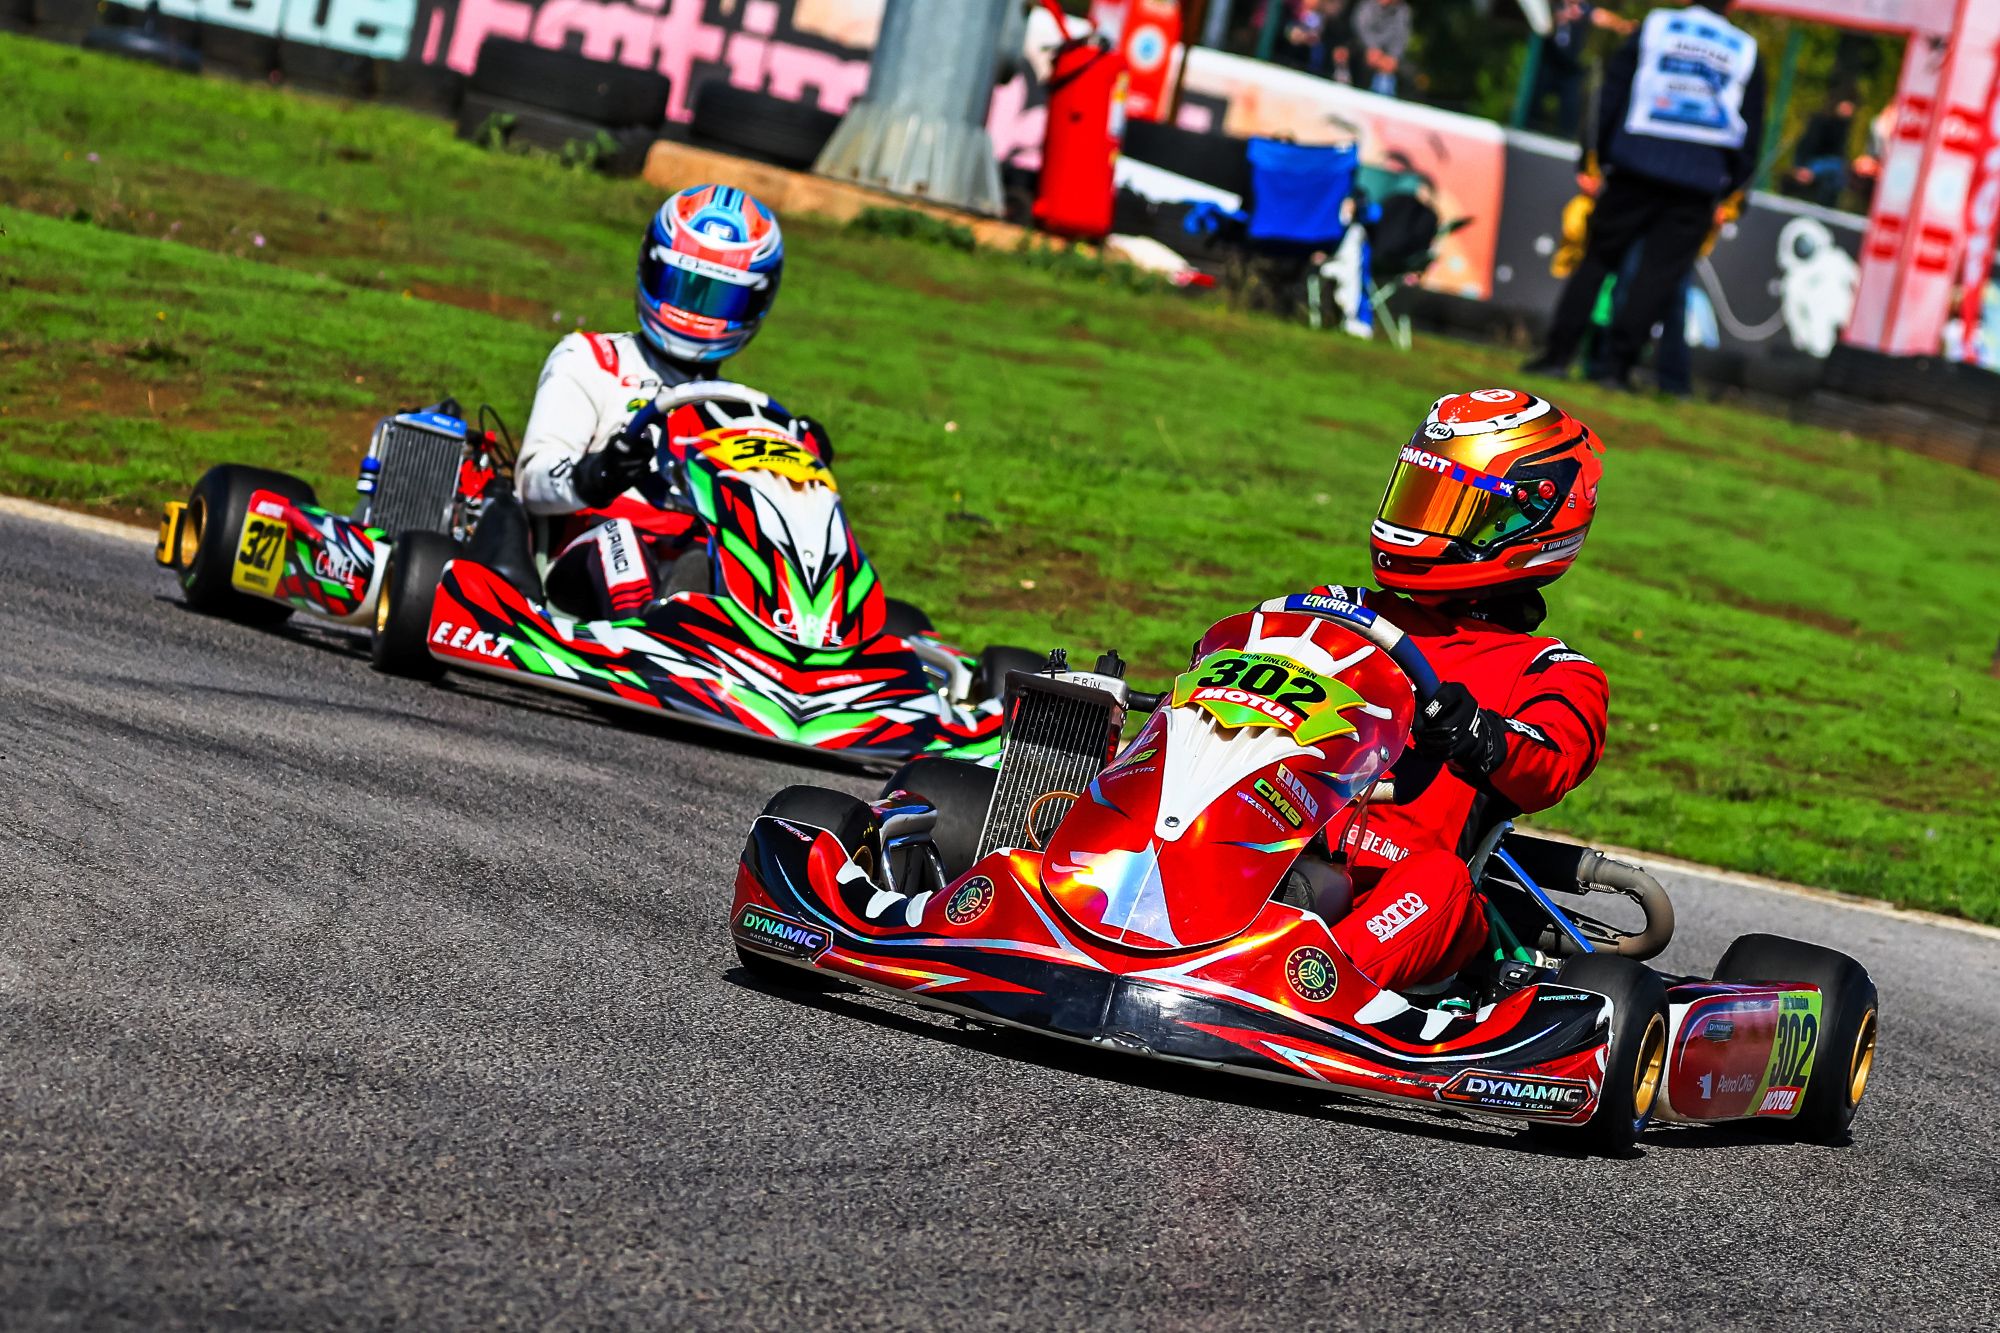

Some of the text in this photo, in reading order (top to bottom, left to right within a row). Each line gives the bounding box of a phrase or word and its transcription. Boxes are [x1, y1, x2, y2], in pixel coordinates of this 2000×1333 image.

[1194, 688, 1295, 727] MOTUL
[1197, 658, 1327, 721] 302
[1253, 778, 1302, 827] CMS
[743, 912, 823, 949] DYNAMIC
[1366, 892, 1425, 940] sparco
[750, 932, 795, 952] RACING TEAM
[1709, 1022, 1733, 1032] DYNAMIC
[1769, 1013, 1818, 1089] 302
[1465, 1077, 1583, 1103] DYNAMIC
[1480, 1096, 1553, 1110] RACING TEAM
[1758, 1090, 1798, 1111] MOTUL
